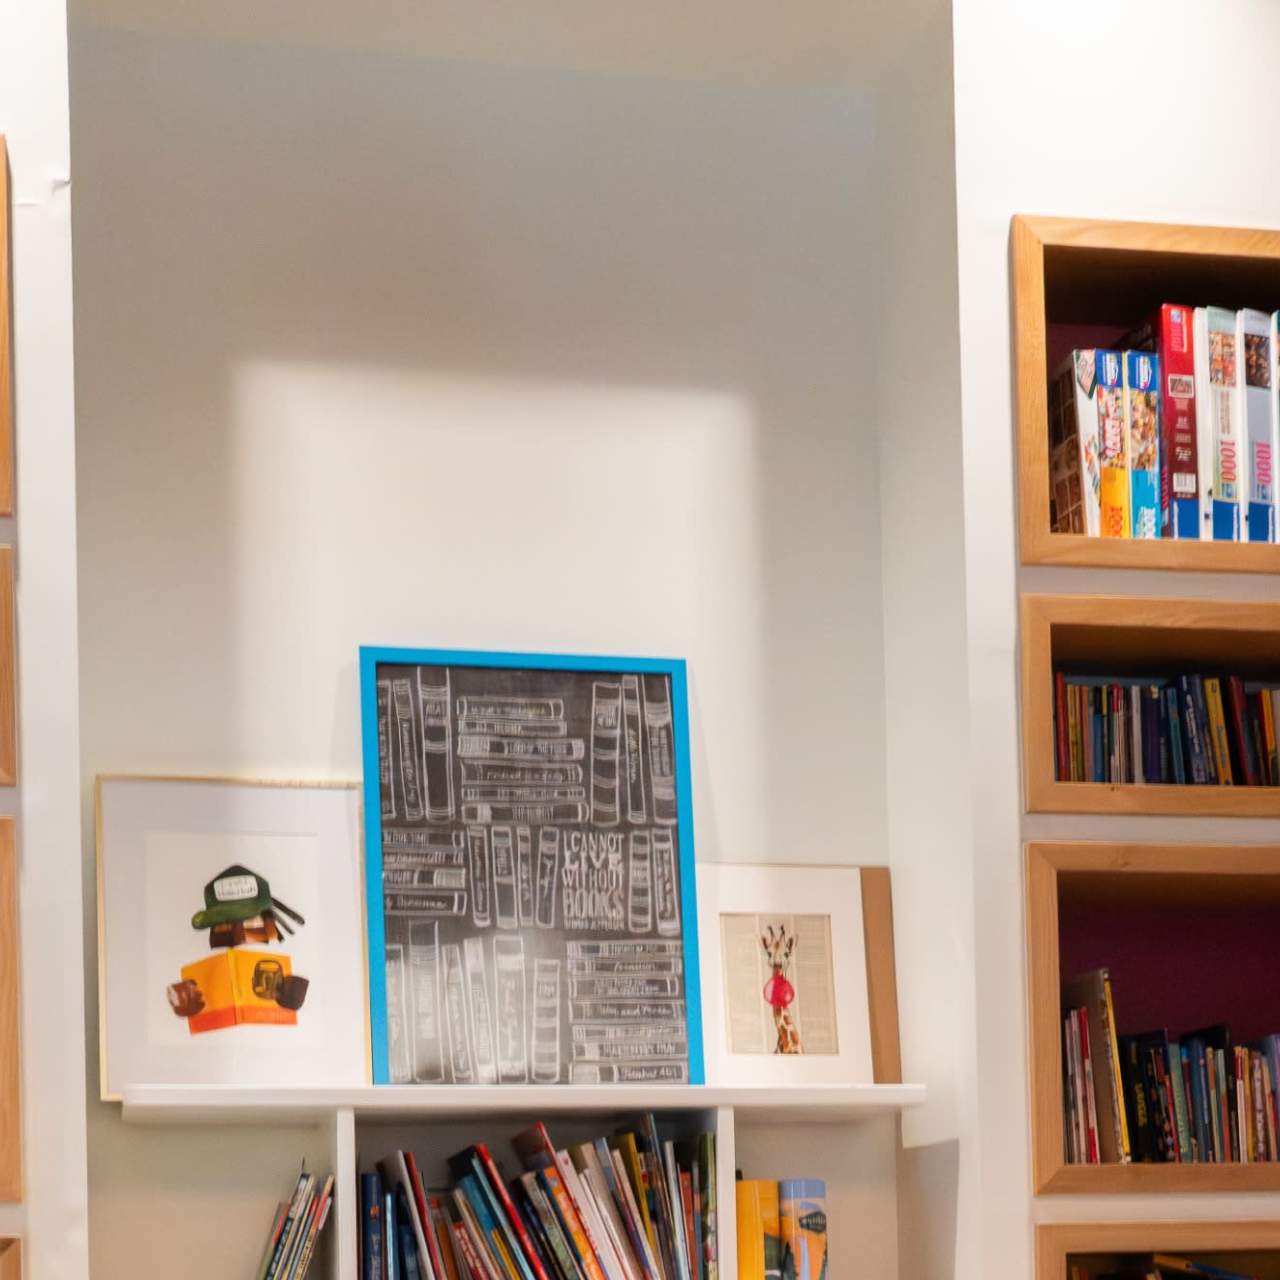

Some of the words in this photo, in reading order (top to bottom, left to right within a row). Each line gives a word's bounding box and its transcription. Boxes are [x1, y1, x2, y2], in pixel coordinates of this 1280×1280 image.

[1220, 439, 1237, 482] 1000
[1253, 440, 1274, 485] 1000
[571, 831, 625, 855] CANNOT
[564, 850, 624, 871] LIVE
[561, 866, 625, 891] WITHOUT
[563, 887, 625, 919] BOOKS
